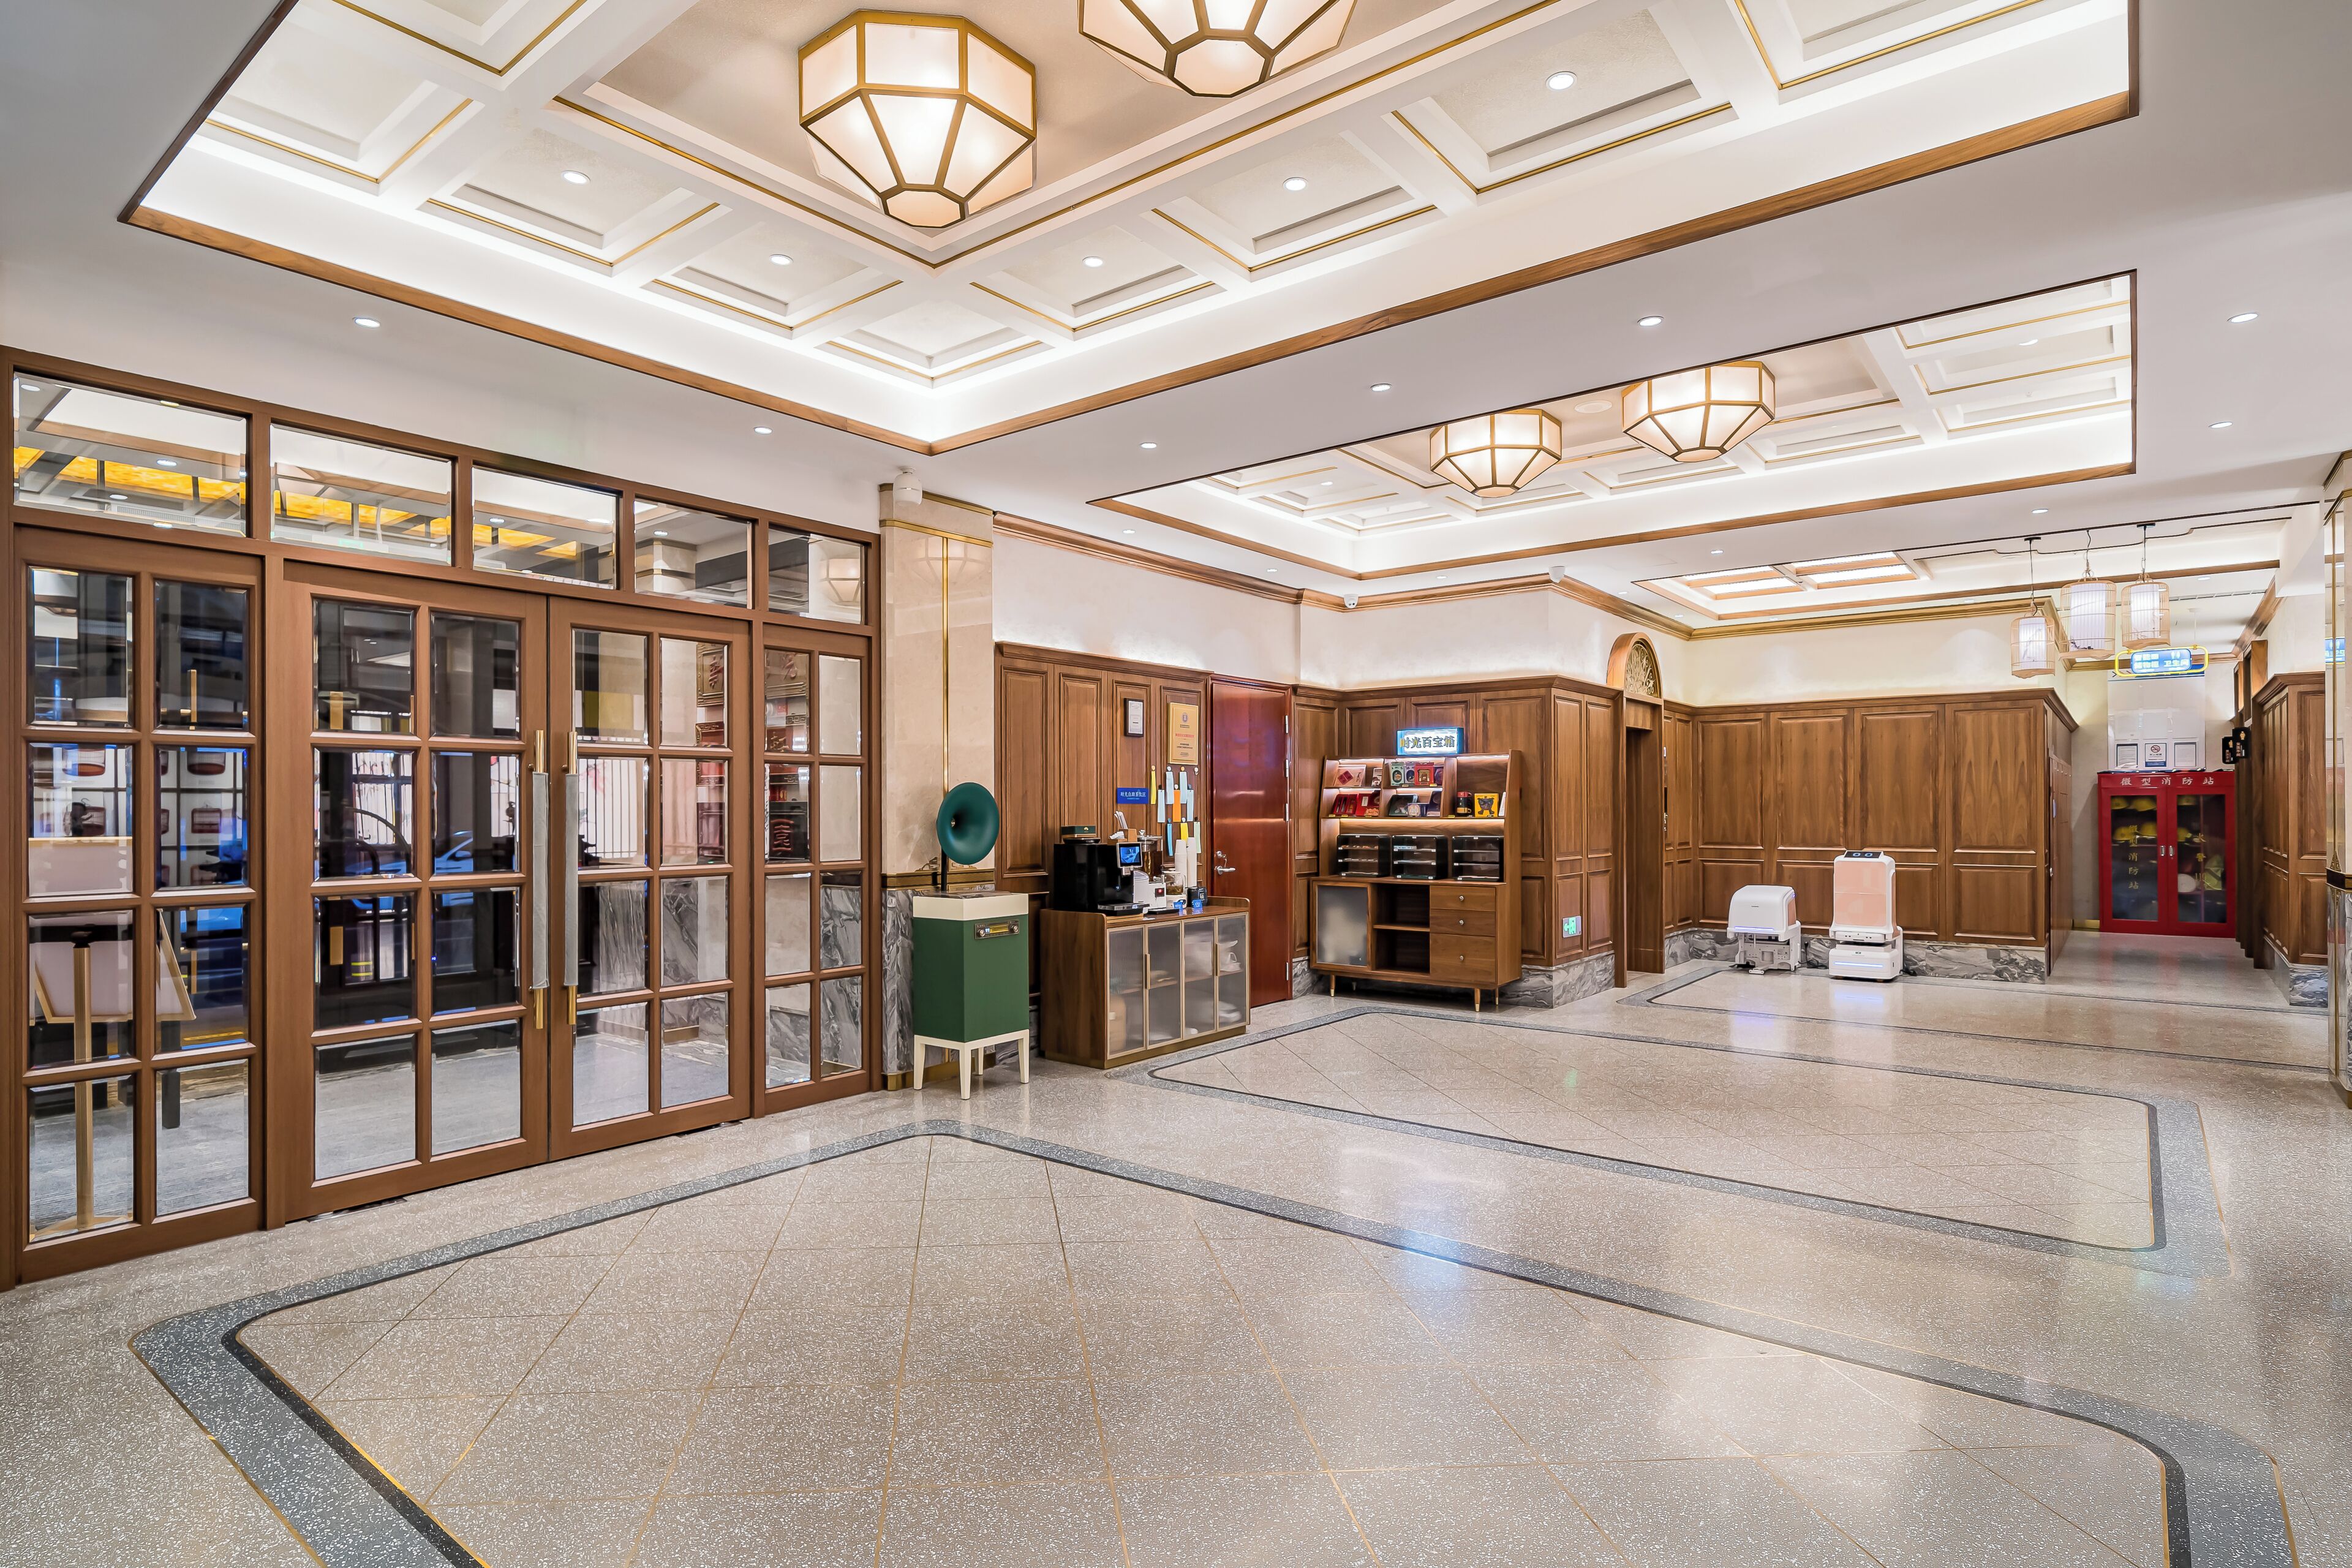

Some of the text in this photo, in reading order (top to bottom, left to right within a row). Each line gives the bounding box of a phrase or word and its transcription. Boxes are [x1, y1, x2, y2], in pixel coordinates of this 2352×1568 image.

[2163, 659, 2190, 668] 卫生间
[1400, 736, 1455, 748] 时光百宝箱
[2120, 777, 2215, 786] 微型消防站
[2128, 824, 2139, 889] 微型消防站
